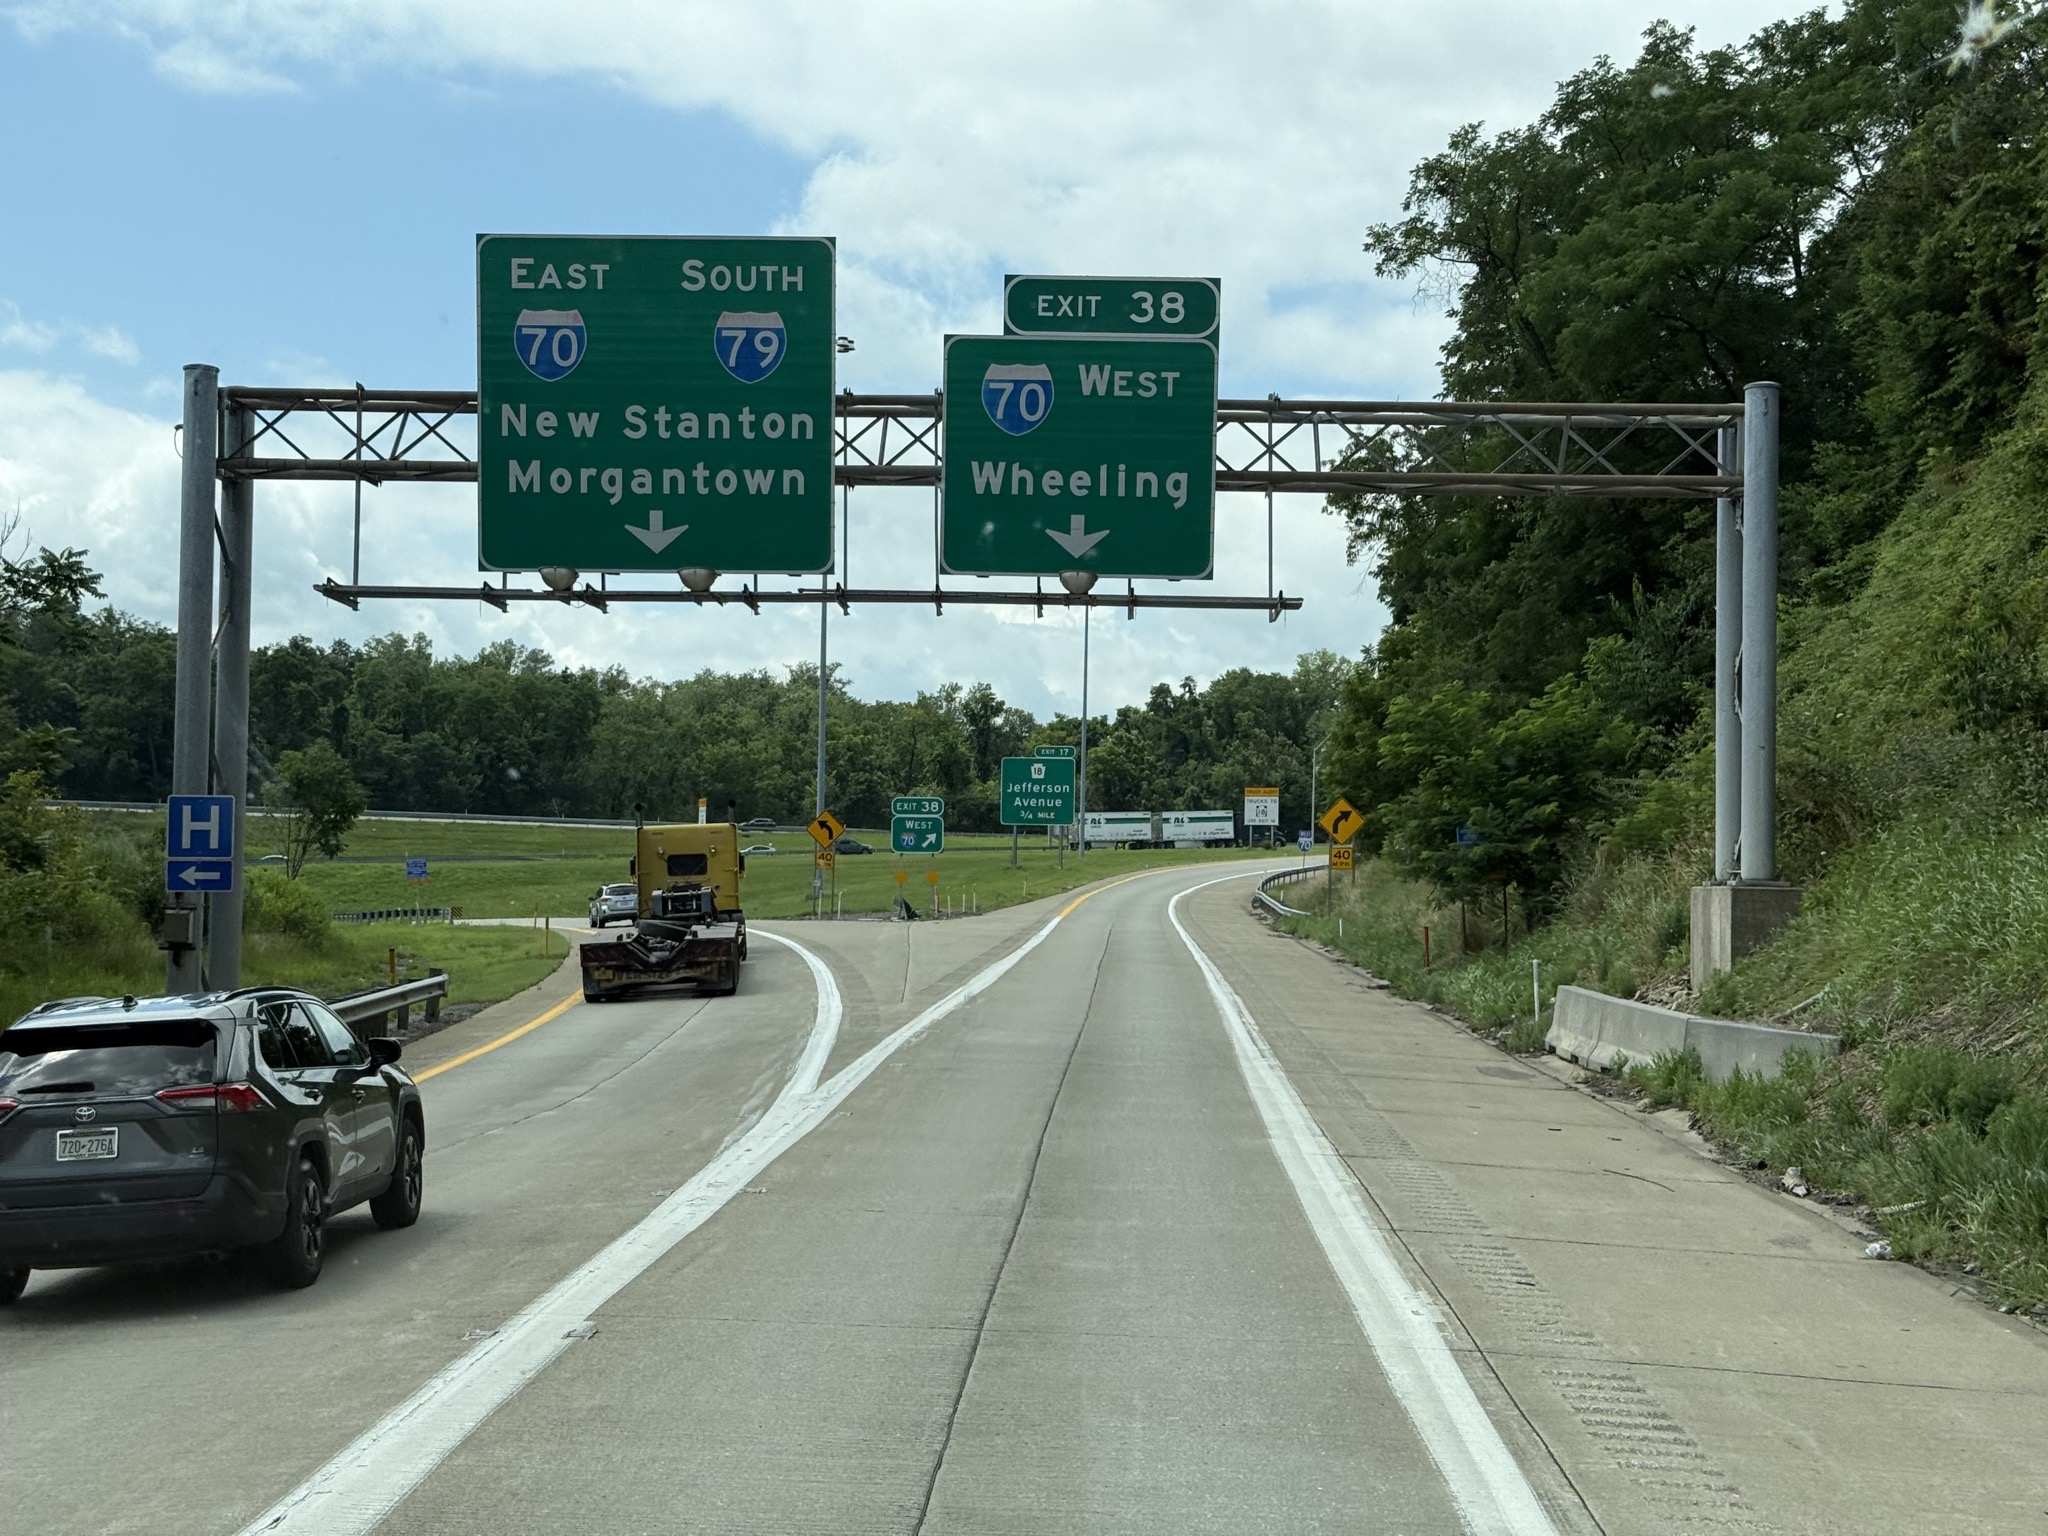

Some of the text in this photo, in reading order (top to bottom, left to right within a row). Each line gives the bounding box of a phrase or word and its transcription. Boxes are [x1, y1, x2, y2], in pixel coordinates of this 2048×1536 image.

[510, 258, 609, 290] EAST
[680, 259, 804, 292] SOUTH
[1037, 291, 1185, 324] EXIT 38
[521, 328, 578, 367] 70
[721, 330, 780, 369] 79
[1078, 364, 1180, 398] WEST
[989, 382, 1045, 422] 70
[502, 403, 814, 439] New Stanton
[508, 460, 806, 506] Morgantown
[971, 461, 1188, 510] Wheeling
[1060, 748, 1069, 756] 17
[1007, 782, 1070, 793] Jefferson
[1033, 767, 1043, 776] 18
[896, 801, 939, 812] EXIT 38
[1013, 797, 1062, 807] Avenue
[181, 804, 220, 850] H
[905, 820, 933, 829] WEST
[818, 852, 833, 861] 40
[902, 836, 915, 846] 70
[1299, 841, 1311, 850] 70
[1333, 850, 1351, 860] 40
